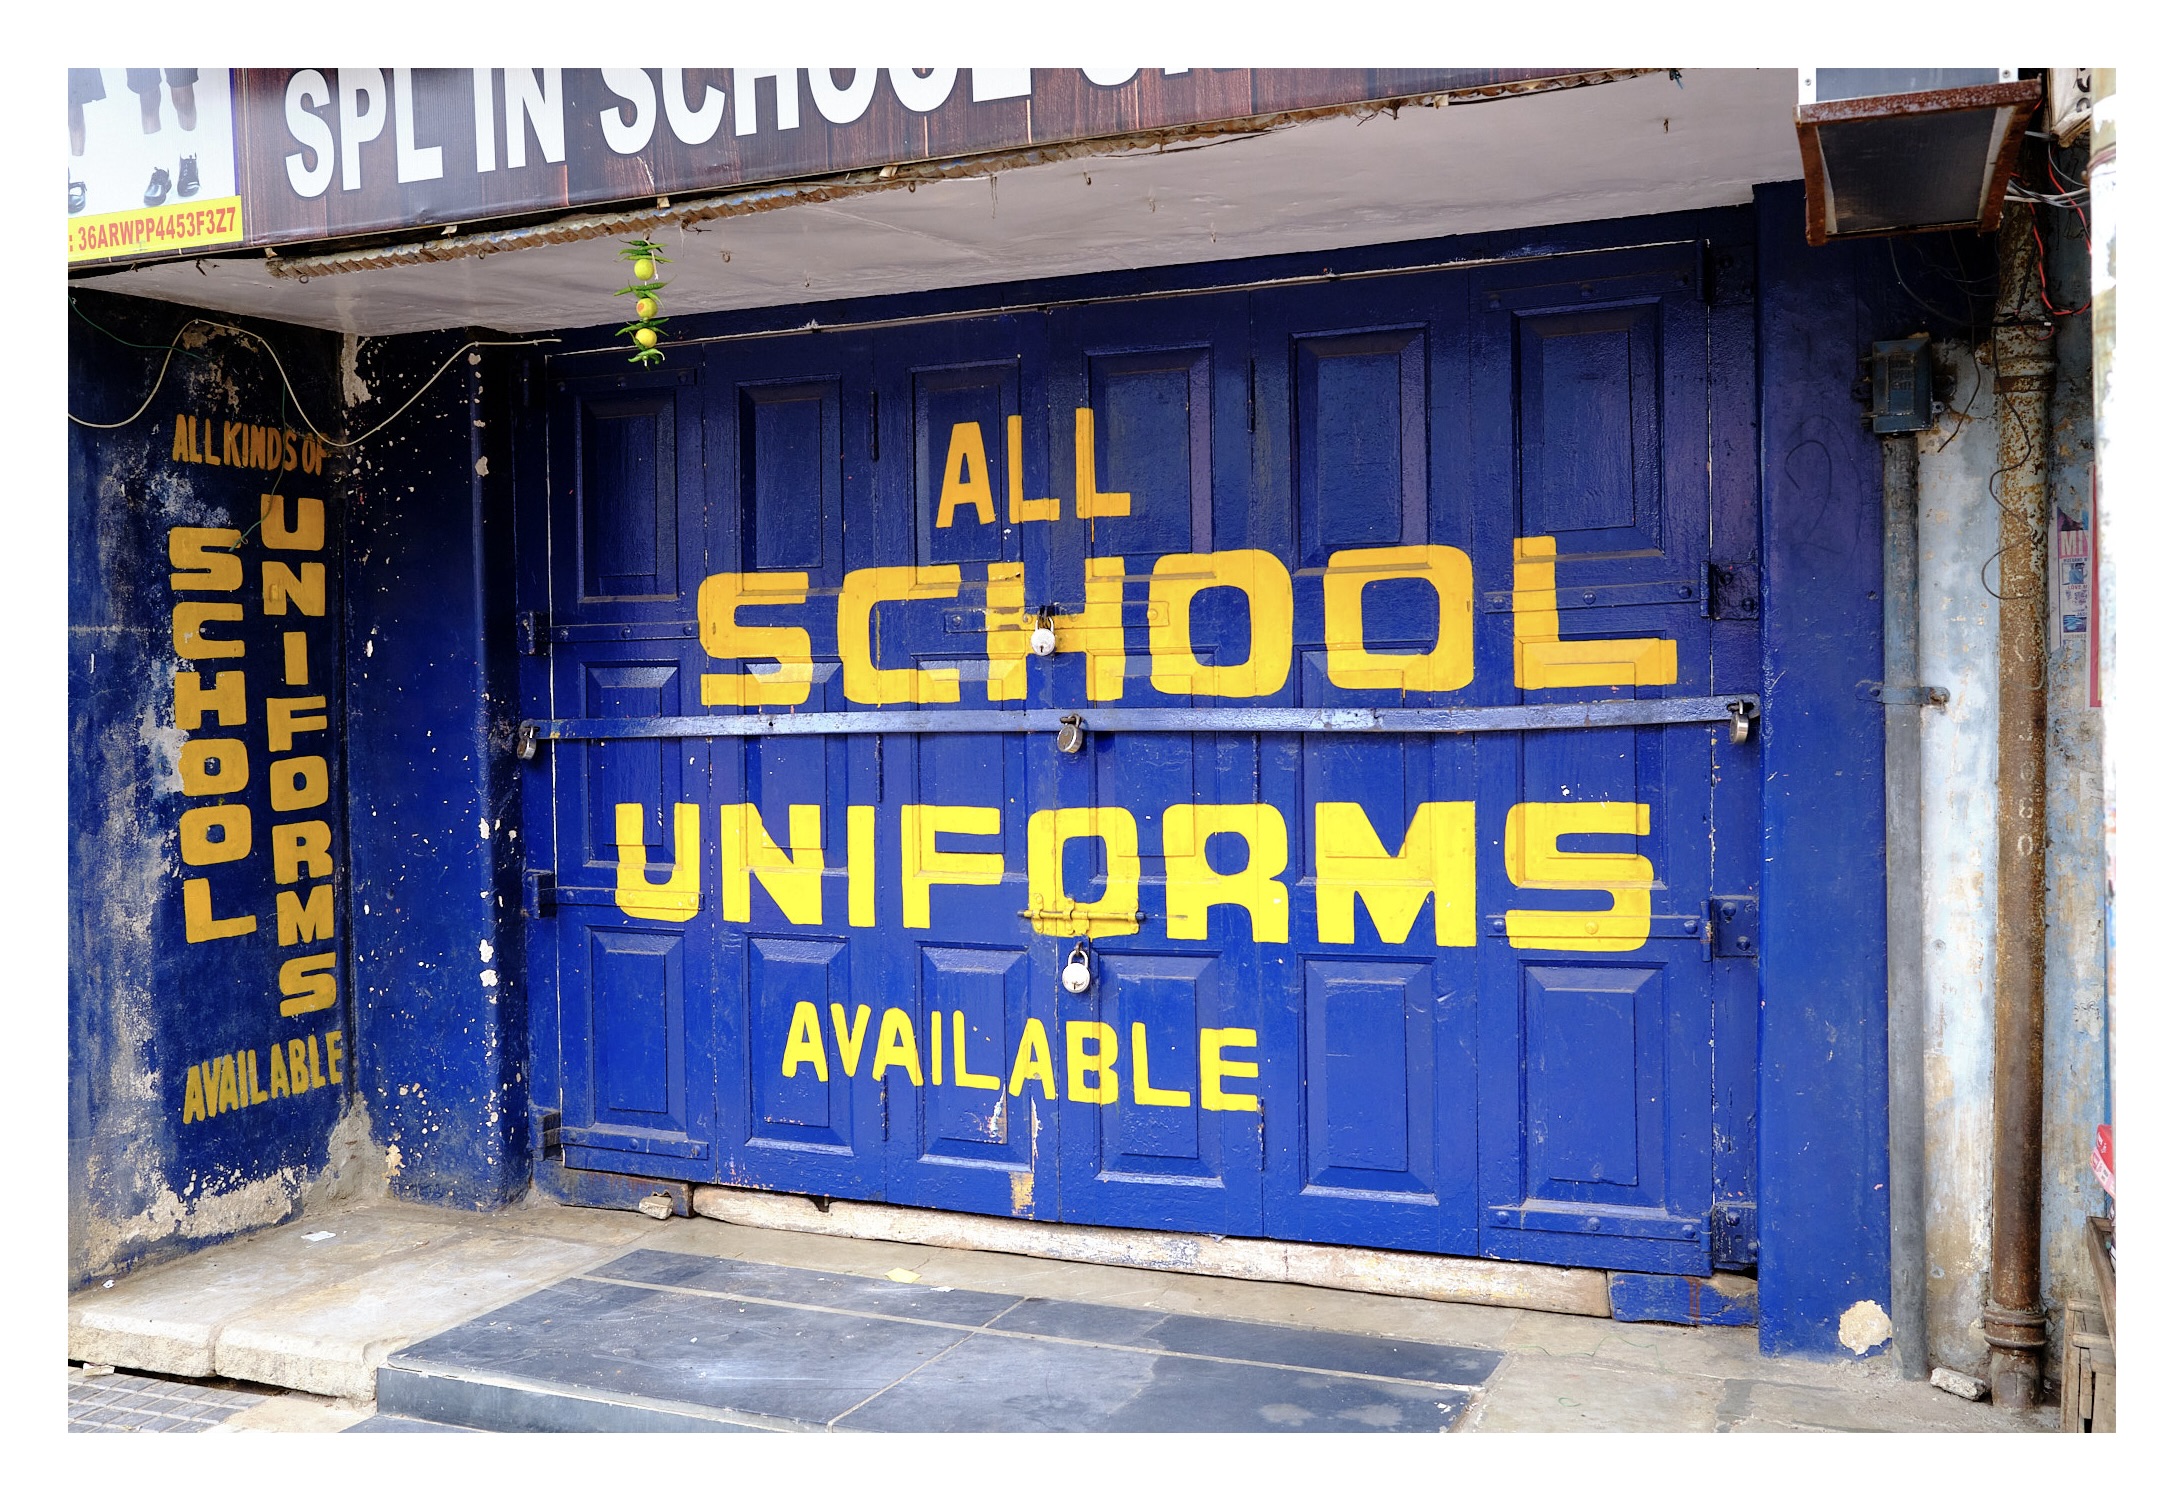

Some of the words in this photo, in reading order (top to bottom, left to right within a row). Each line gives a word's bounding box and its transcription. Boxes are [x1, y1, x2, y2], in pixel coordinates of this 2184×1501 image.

[285, 68, 443, 197] SPL
[473, 68, 565, 173] IN
[78, 206, 236, 251] 36ARWPP4453F3Z7
[172, 413, 221, 466] ALL
[223, 420, 298, 472] KINDS
[935, 407, 1132, 528] ALL
[697, 535, 1678, 706] SCHOOL
[168, 526, 257, 945] SCHOOL
[260, 493, 338, 1018] UNIFORMS
[614, 800, 1655, 951] UNIFORMS
[182, 1030, 344, 1125] AVAILABLE
[782, 1000, 1260, 1112] AVAILABLE
